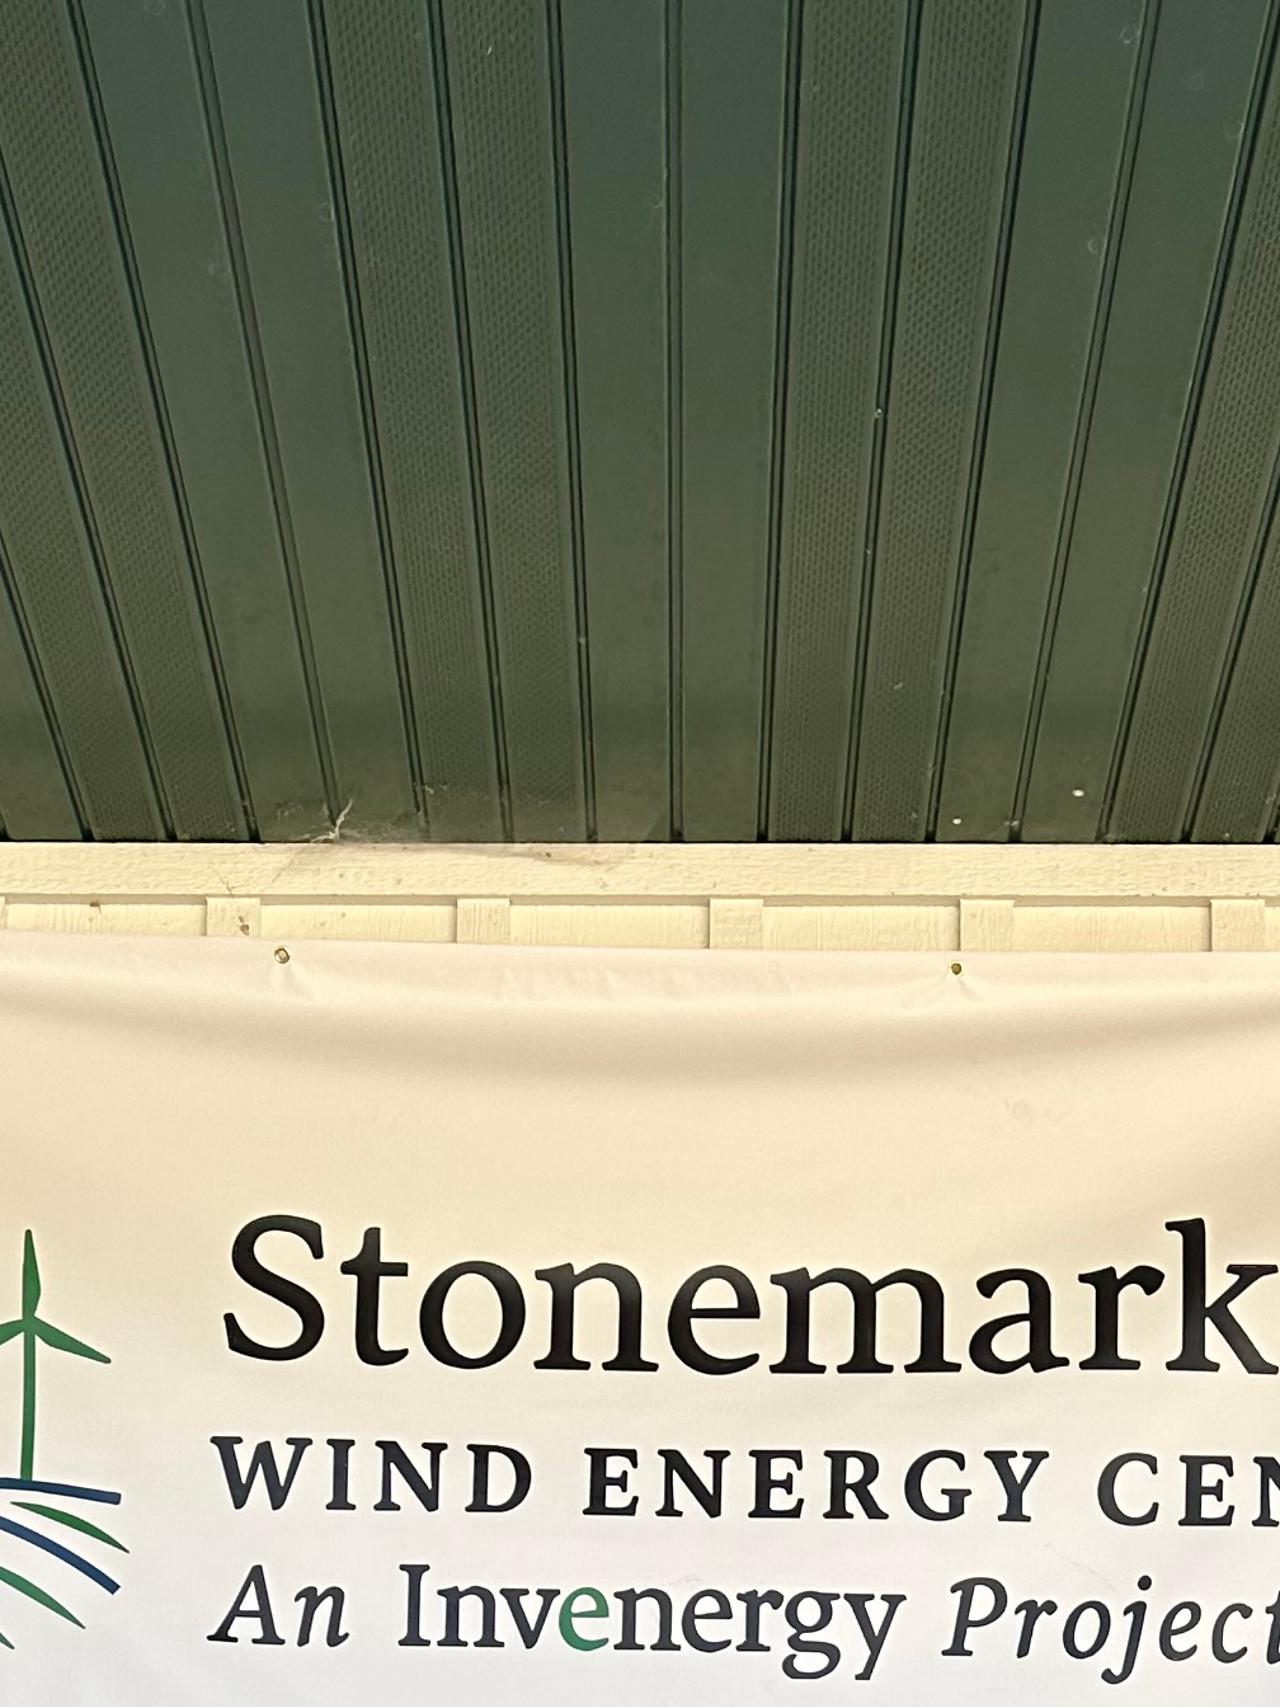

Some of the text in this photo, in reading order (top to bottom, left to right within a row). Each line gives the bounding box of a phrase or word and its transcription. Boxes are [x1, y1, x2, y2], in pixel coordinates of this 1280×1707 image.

[222, 1213, 1280, 1377] Stonemark
[208, 1434, 533, 1514] WIND
[581, 1446, 1051, 1524] ENERGY
[205, 1563, 351, 1649] An
[397, 1563, 908, 1682] Invenergy
